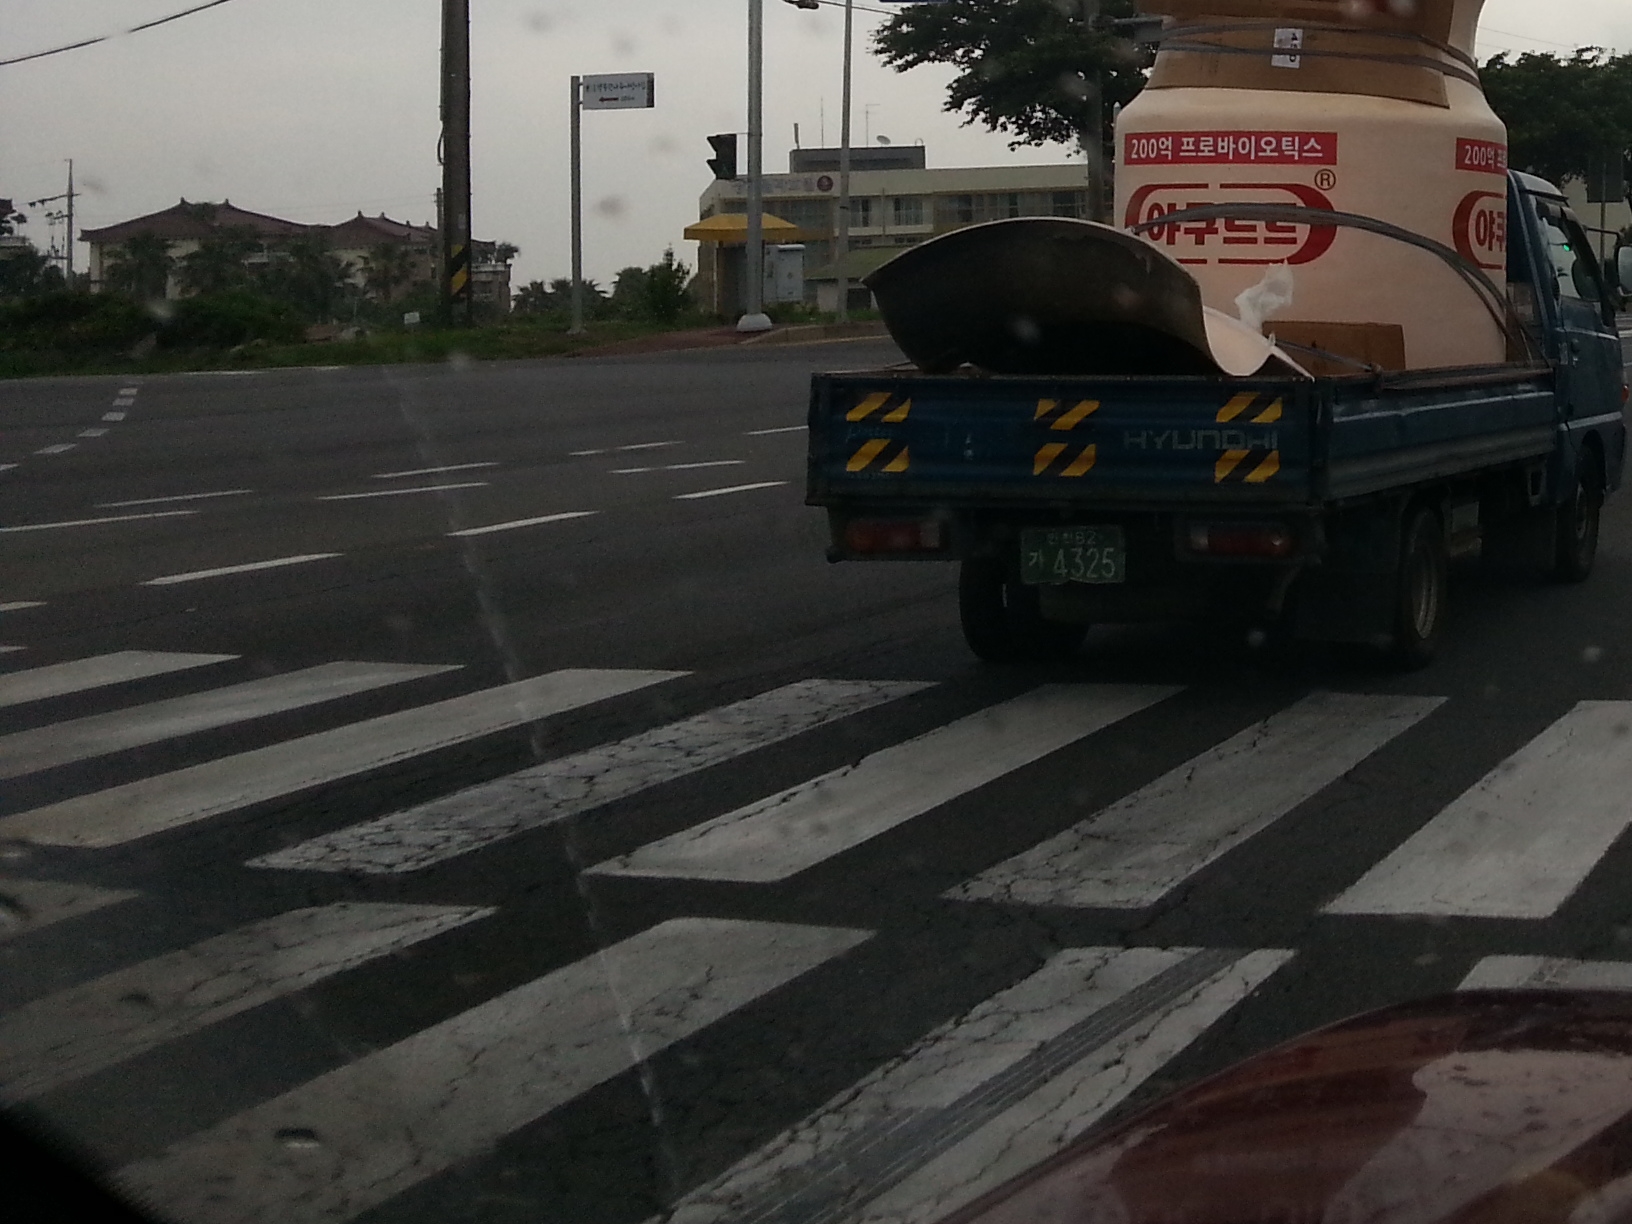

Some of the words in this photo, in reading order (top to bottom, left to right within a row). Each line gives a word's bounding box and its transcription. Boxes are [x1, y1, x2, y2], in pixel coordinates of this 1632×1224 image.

[1131, 136, 1173, 160] 200억
[1179, 135, 1323, 160] 프로바이오틱스
[1053, 547, 1116, 578] 4325
